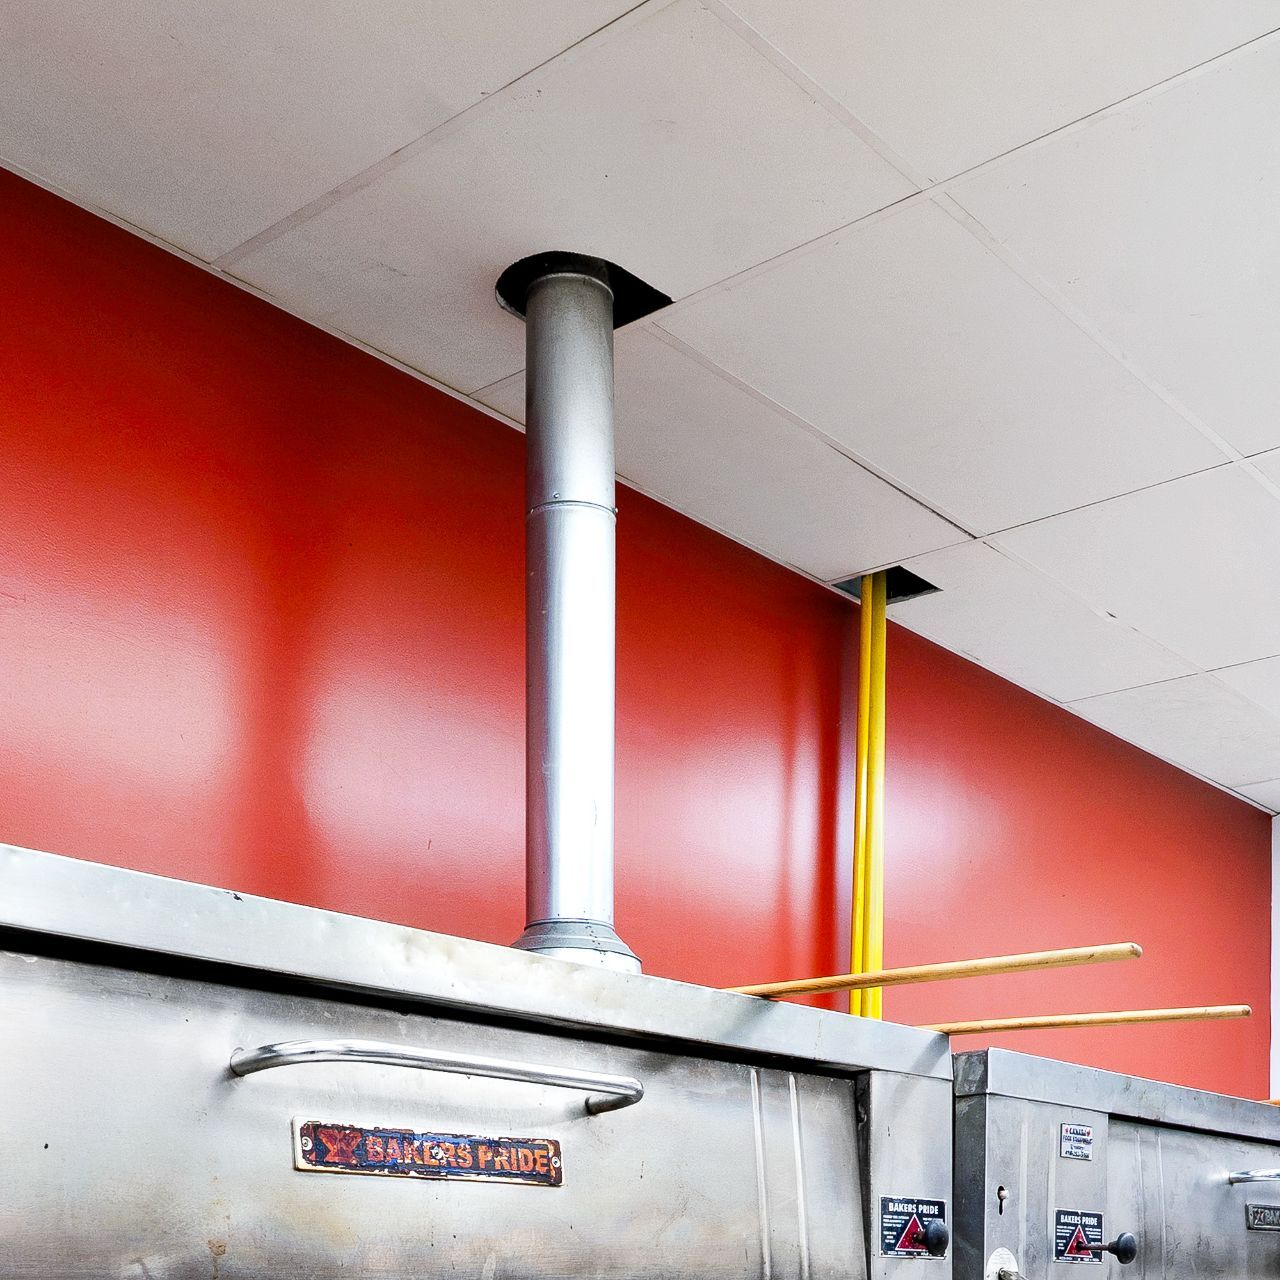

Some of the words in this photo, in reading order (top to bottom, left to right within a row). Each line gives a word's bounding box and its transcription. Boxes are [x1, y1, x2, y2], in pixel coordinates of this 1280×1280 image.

[365, 1135, 475, 1169] BAKERS
[478, 1144, 550, 1174] PRIDE
[888, 1202, 917, 1213] BAKERS
[918, 1204, 939, 1215] PRIDE
[1060, 1214, 1081, 1224] BAKERS
[1082, 1216, 1098, 1226] PRIDE
